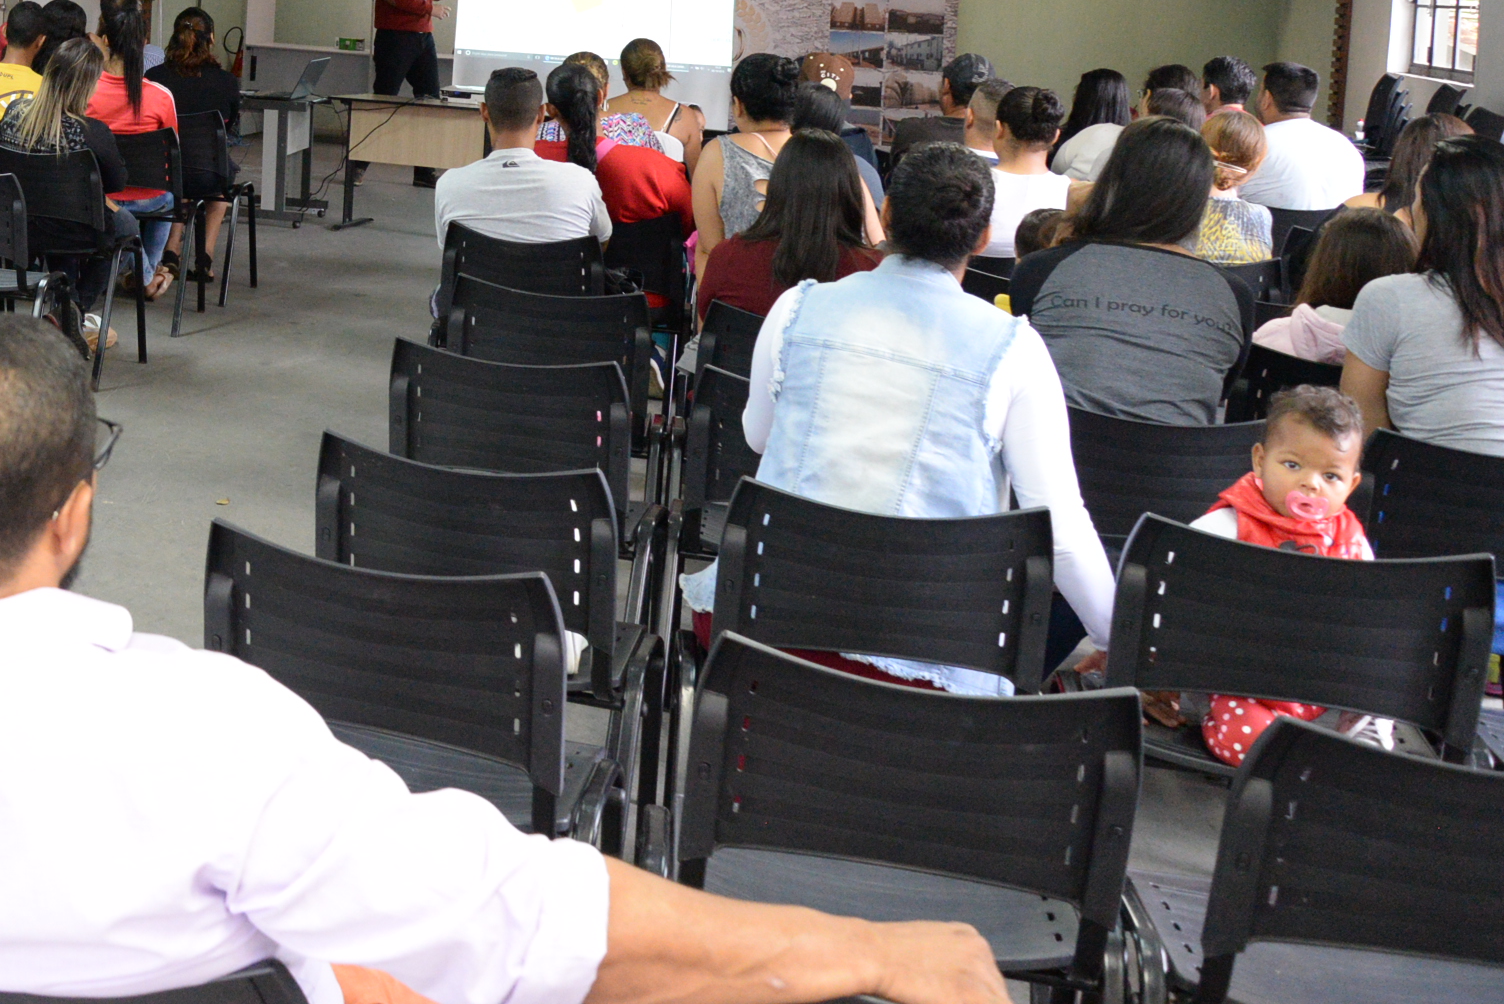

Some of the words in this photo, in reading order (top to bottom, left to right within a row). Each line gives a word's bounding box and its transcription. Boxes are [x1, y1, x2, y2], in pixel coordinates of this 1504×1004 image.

[1050, 294, 1088, 309] Can
[1095, 296, 1100, 309] I
[1107, 300, 1154, 317] pray
[1161, 304, 1188, 320] for
